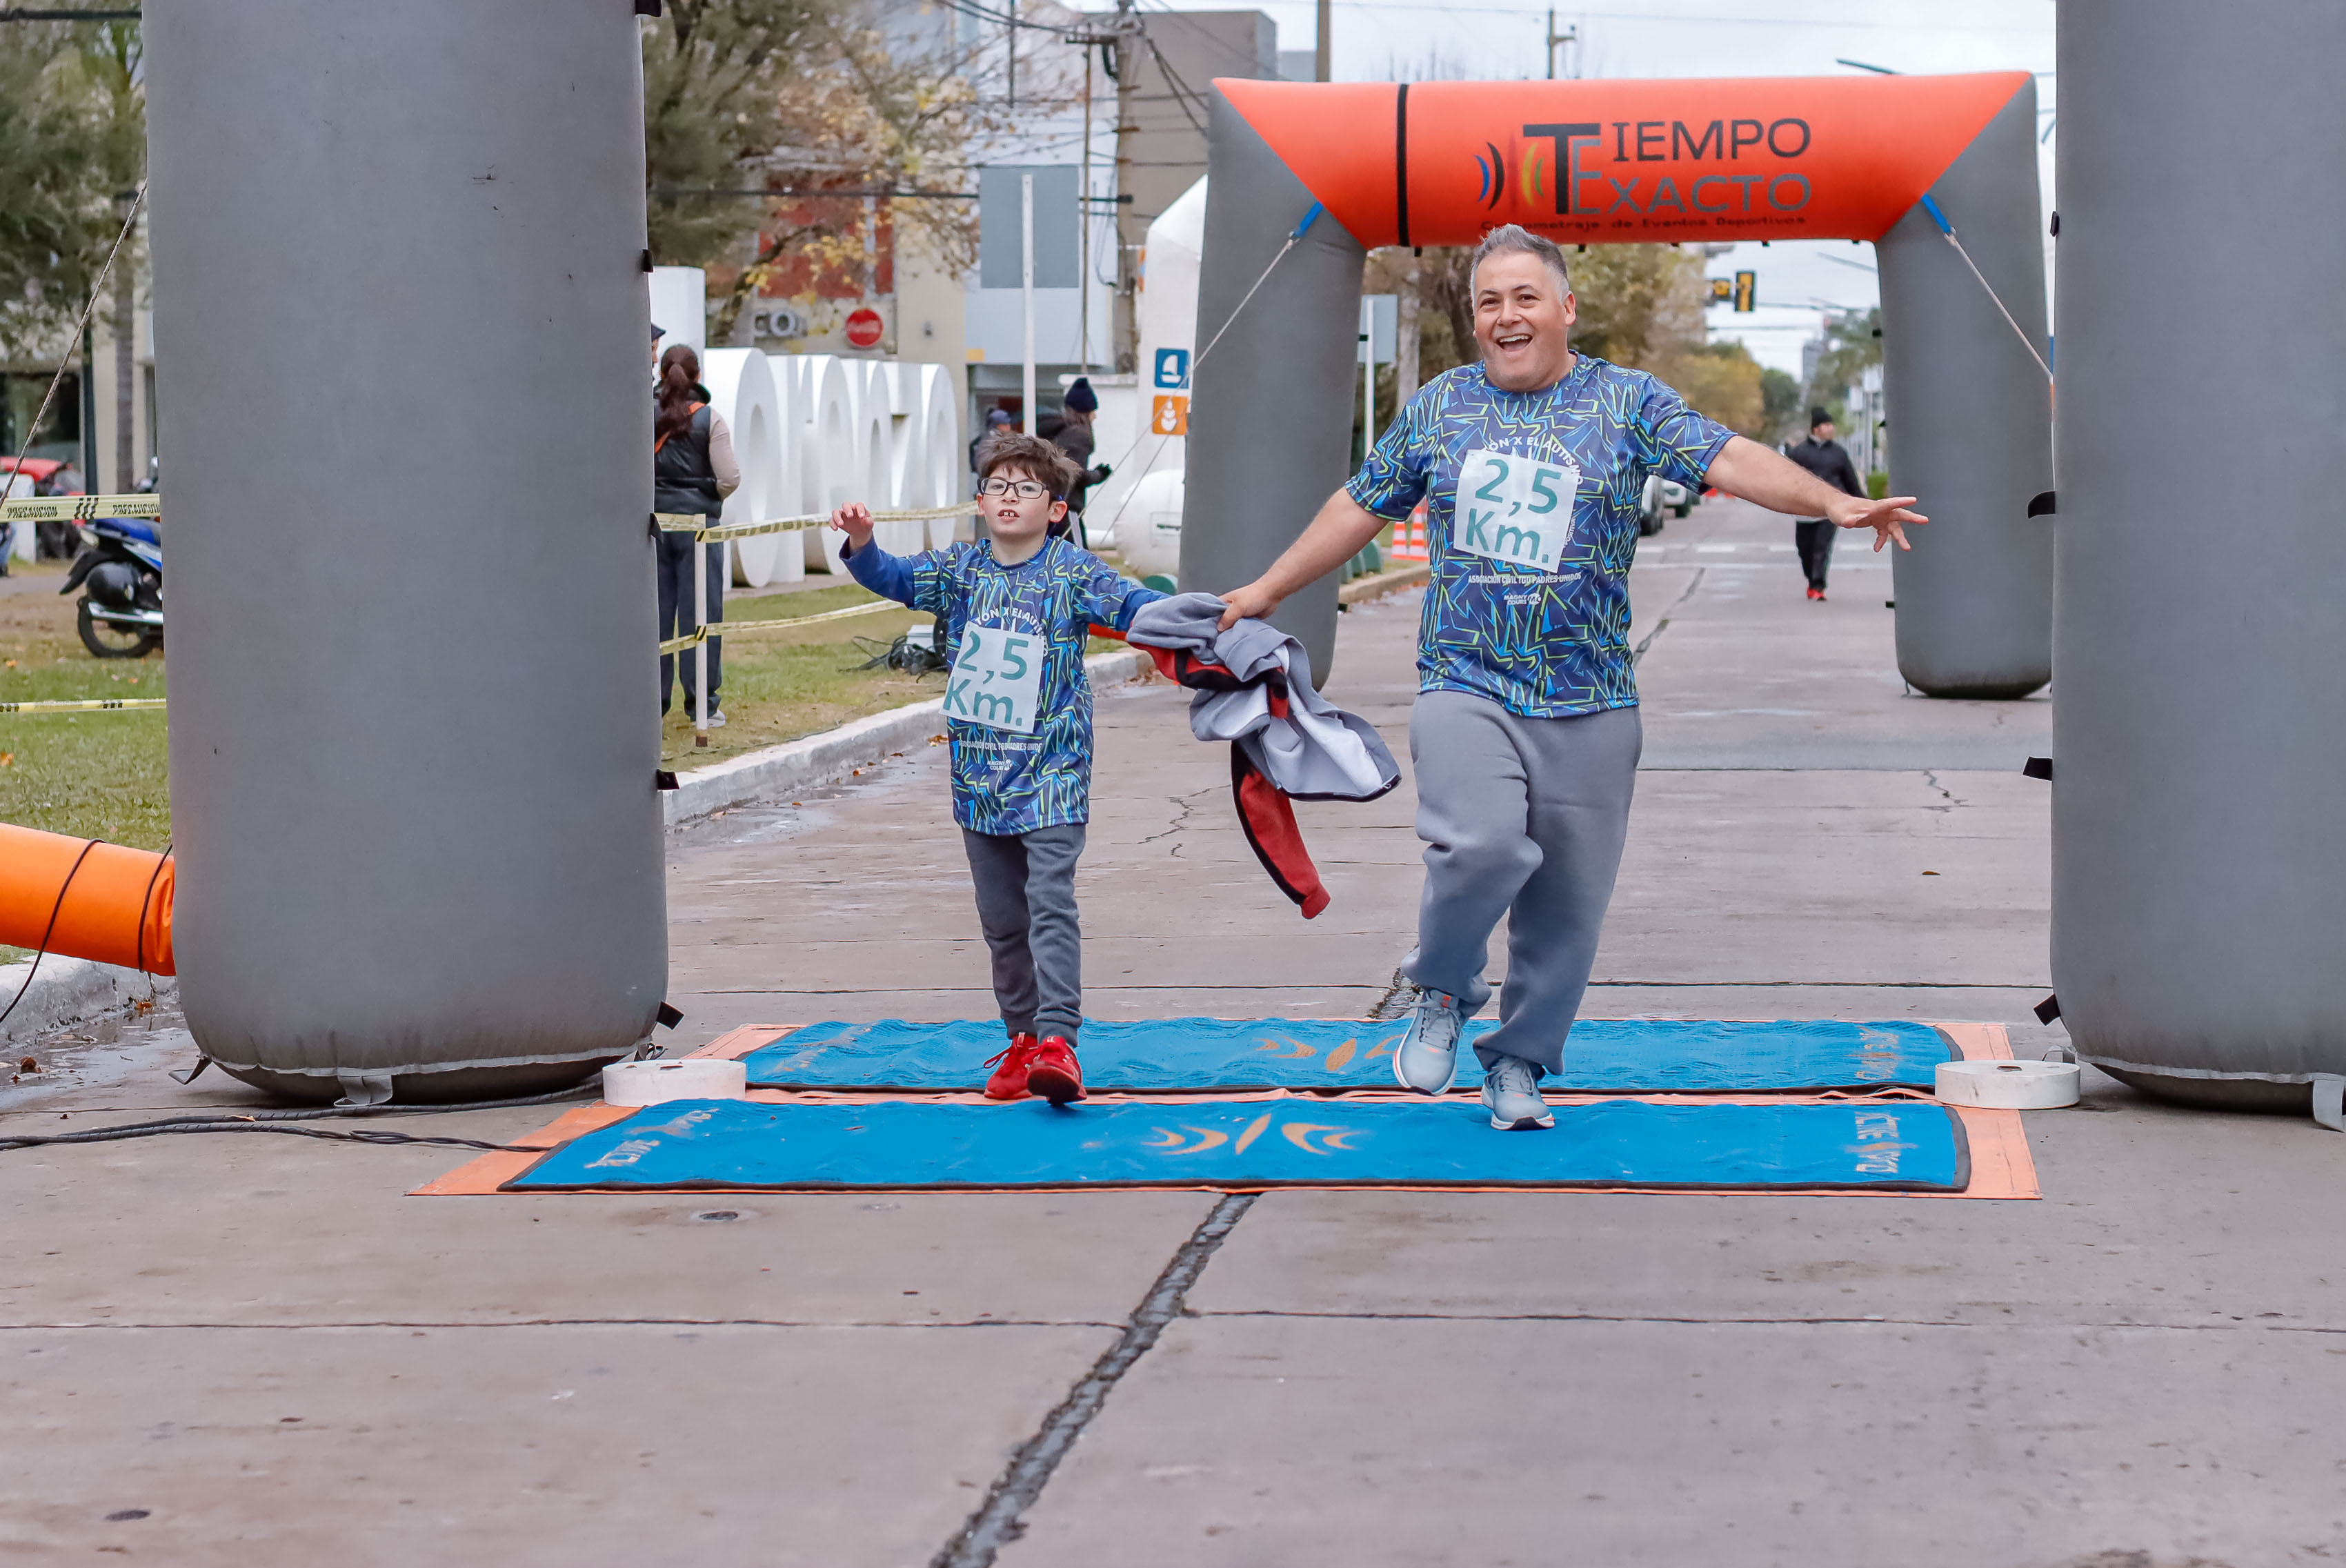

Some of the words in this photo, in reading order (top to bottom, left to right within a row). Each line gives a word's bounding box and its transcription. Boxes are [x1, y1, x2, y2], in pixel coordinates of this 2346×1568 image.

[1523, 118, 1811, 215] TIEMPO
[1571, 139, 1811, 215] EXACTO
[1611, 219, 1632, 228] de
[1642, 218, 1708, 228] Eventos
[1716, 217, 1805, 228] Deportivos
[1513, 436, 1522, 445] X
[1527, 437, 1540, 446] EL
[7, 506, 59, 519] PRECAUCION
[1475, 459, 1563, 517] 2,5
[1466, 508, 1549, 564] Km.
[1502, 574, 1518, 584] CIVIL
[1532, 575, 1558, 584] PADRES
[1559, 572, 1582, 582] UNIDOS
[1002, 606, 1009, 616] X
[957, 631, 1028, 684] 2,5
[943, 677, 1023, 726] Km.
